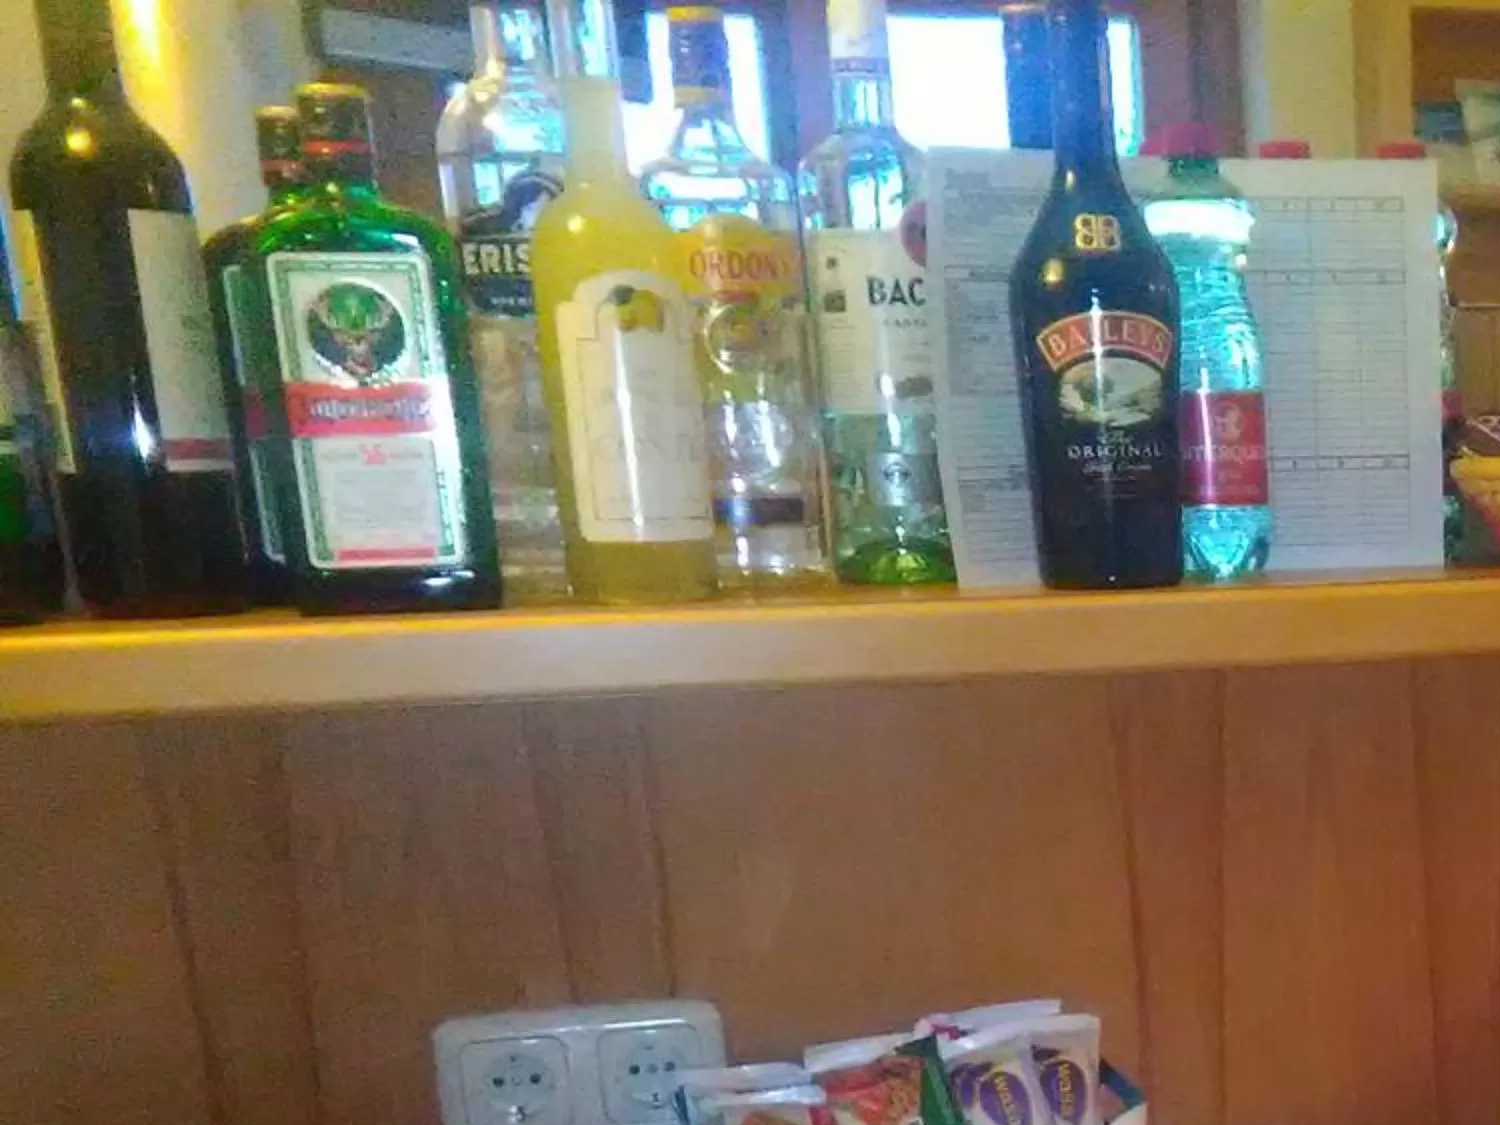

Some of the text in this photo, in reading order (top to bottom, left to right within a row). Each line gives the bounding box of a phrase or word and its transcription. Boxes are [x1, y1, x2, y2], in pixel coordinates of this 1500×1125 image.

[866, 275, 927, 307] BAC
[1046, 322, 1166, 354] BALEYS
[1068, 445, 1162, 460] ORIGINAL
